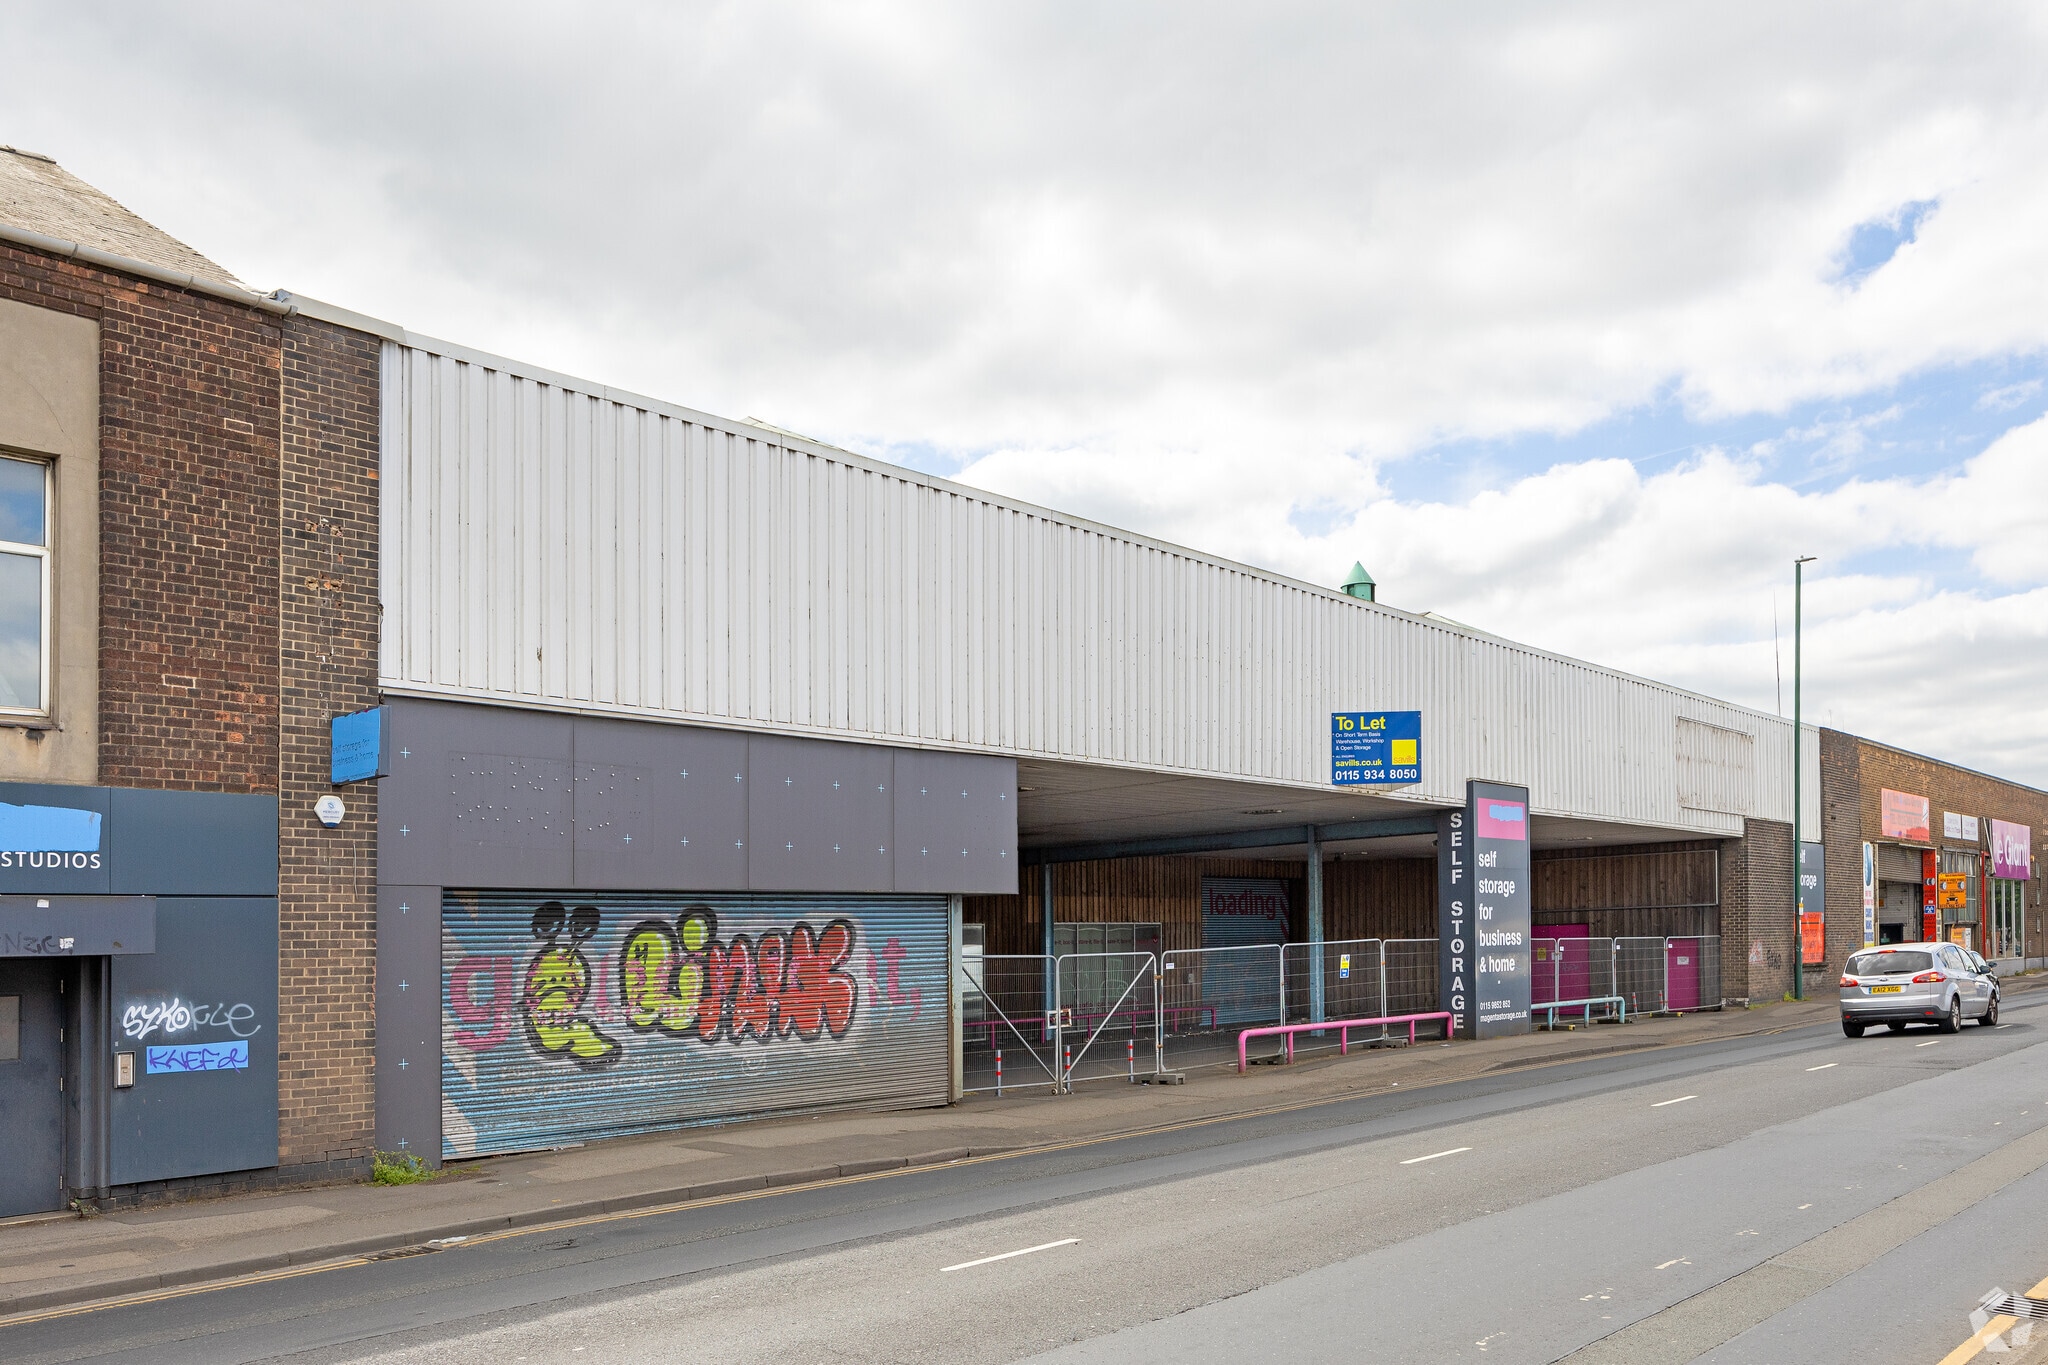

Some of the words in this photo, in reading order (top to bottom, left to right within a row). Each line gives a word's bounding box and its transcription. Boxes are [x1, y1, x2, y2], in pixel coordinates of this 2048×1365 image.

[1335, 716, 1354, 730] To
[1360, 715, 1386, 730] Let
[1335, 758, 1382, 767] savills.co.uk
[1393, 755, 1416, 764] savills
[1335, 770, 1360, 780] 0115
[1364, 769, 1385, 779] 934
[1389, 769, 1417, 779] 8050
[1450, 812, 1463, 885] SELF
[2004, 834, 2028, 867] Giant
[1, 851, 101, 869] STUDIOS
[1478, 850, 1497, 868] self
[1478, 878, 1515, 898] storage
[1800, 874, 1817, 890] orage
[1209, 888, 1276, 920] loading
[1478, 902, 1493, 920] for
[1479, 929, 1522, 947] business
[1450, 900, 1465, 1029] STORAGE
[1479, 956, 1487, 973] &
[1488, 955, 1516, 973] home
[1480, 1001, 1491, 1011] 0115
[1479, 1009, 1527, 1023] magentastorage.co.uk
